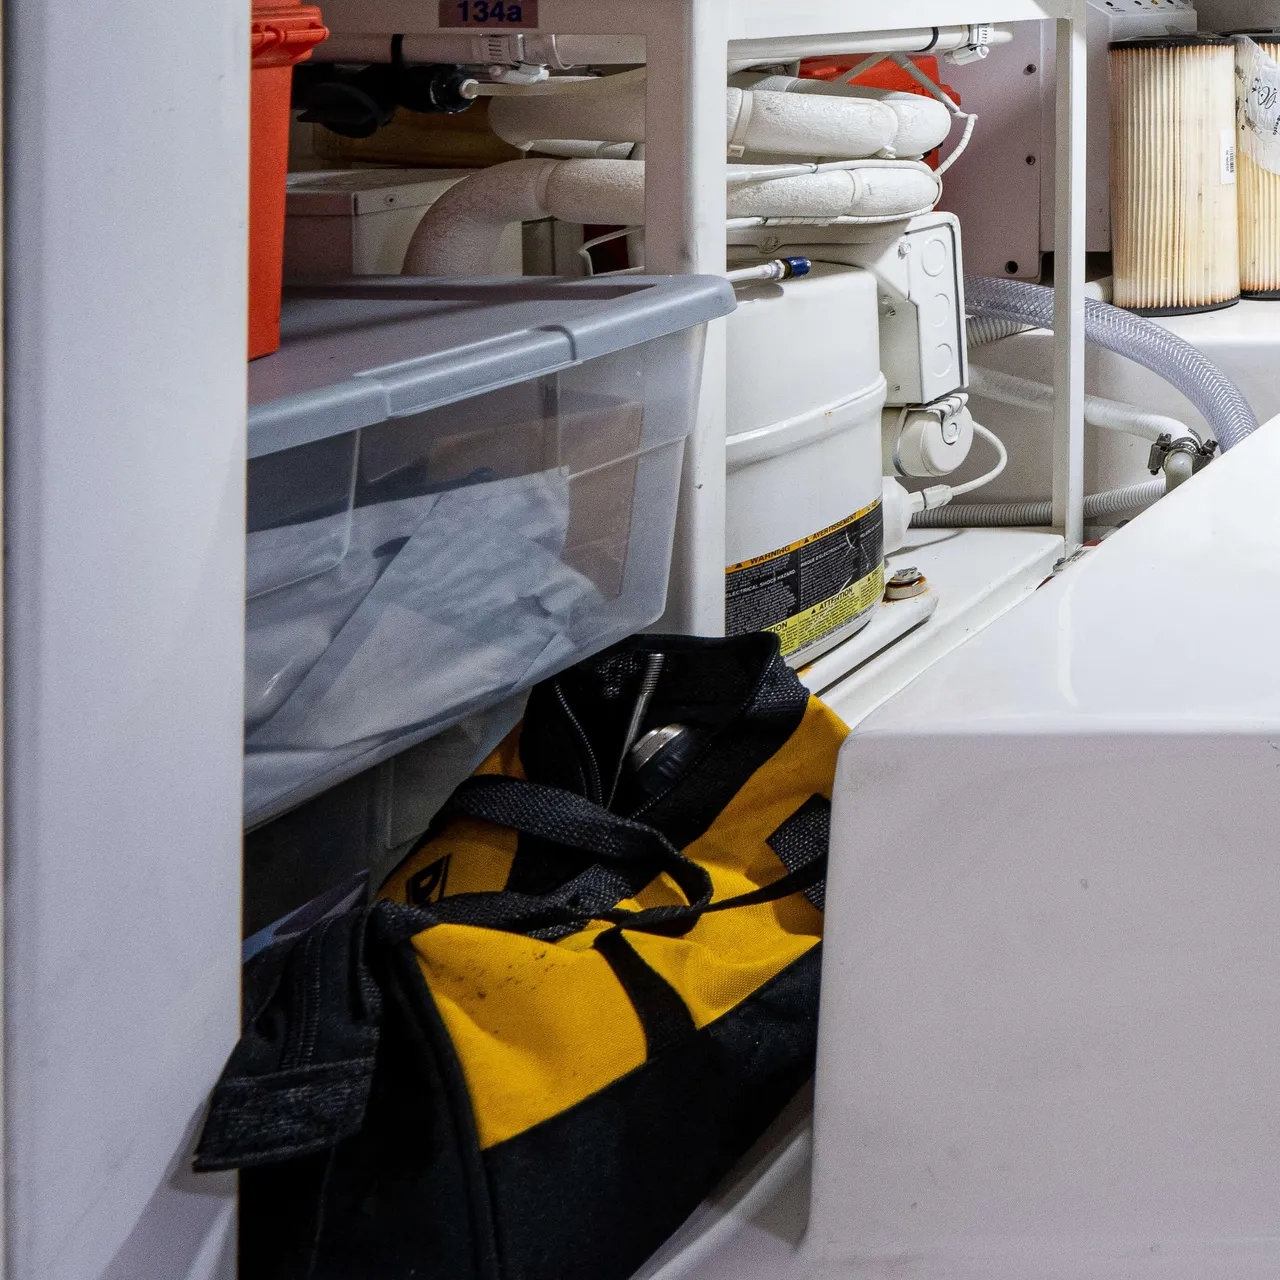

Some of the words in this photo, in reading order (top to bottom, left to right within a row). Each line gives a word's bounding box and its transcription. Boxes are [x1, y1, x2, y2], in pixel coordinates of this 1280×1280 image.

[457, 0, 522, 22] 134a
[812, 514, 857, 540] AVERTISSEMENT
[750, 544, 791, 565] WARNING
[760, 576, 776, 588] SHOCK
[777, 569, 796, 582] HAZARD
[818, 586, 853, 611] ATTENTION
